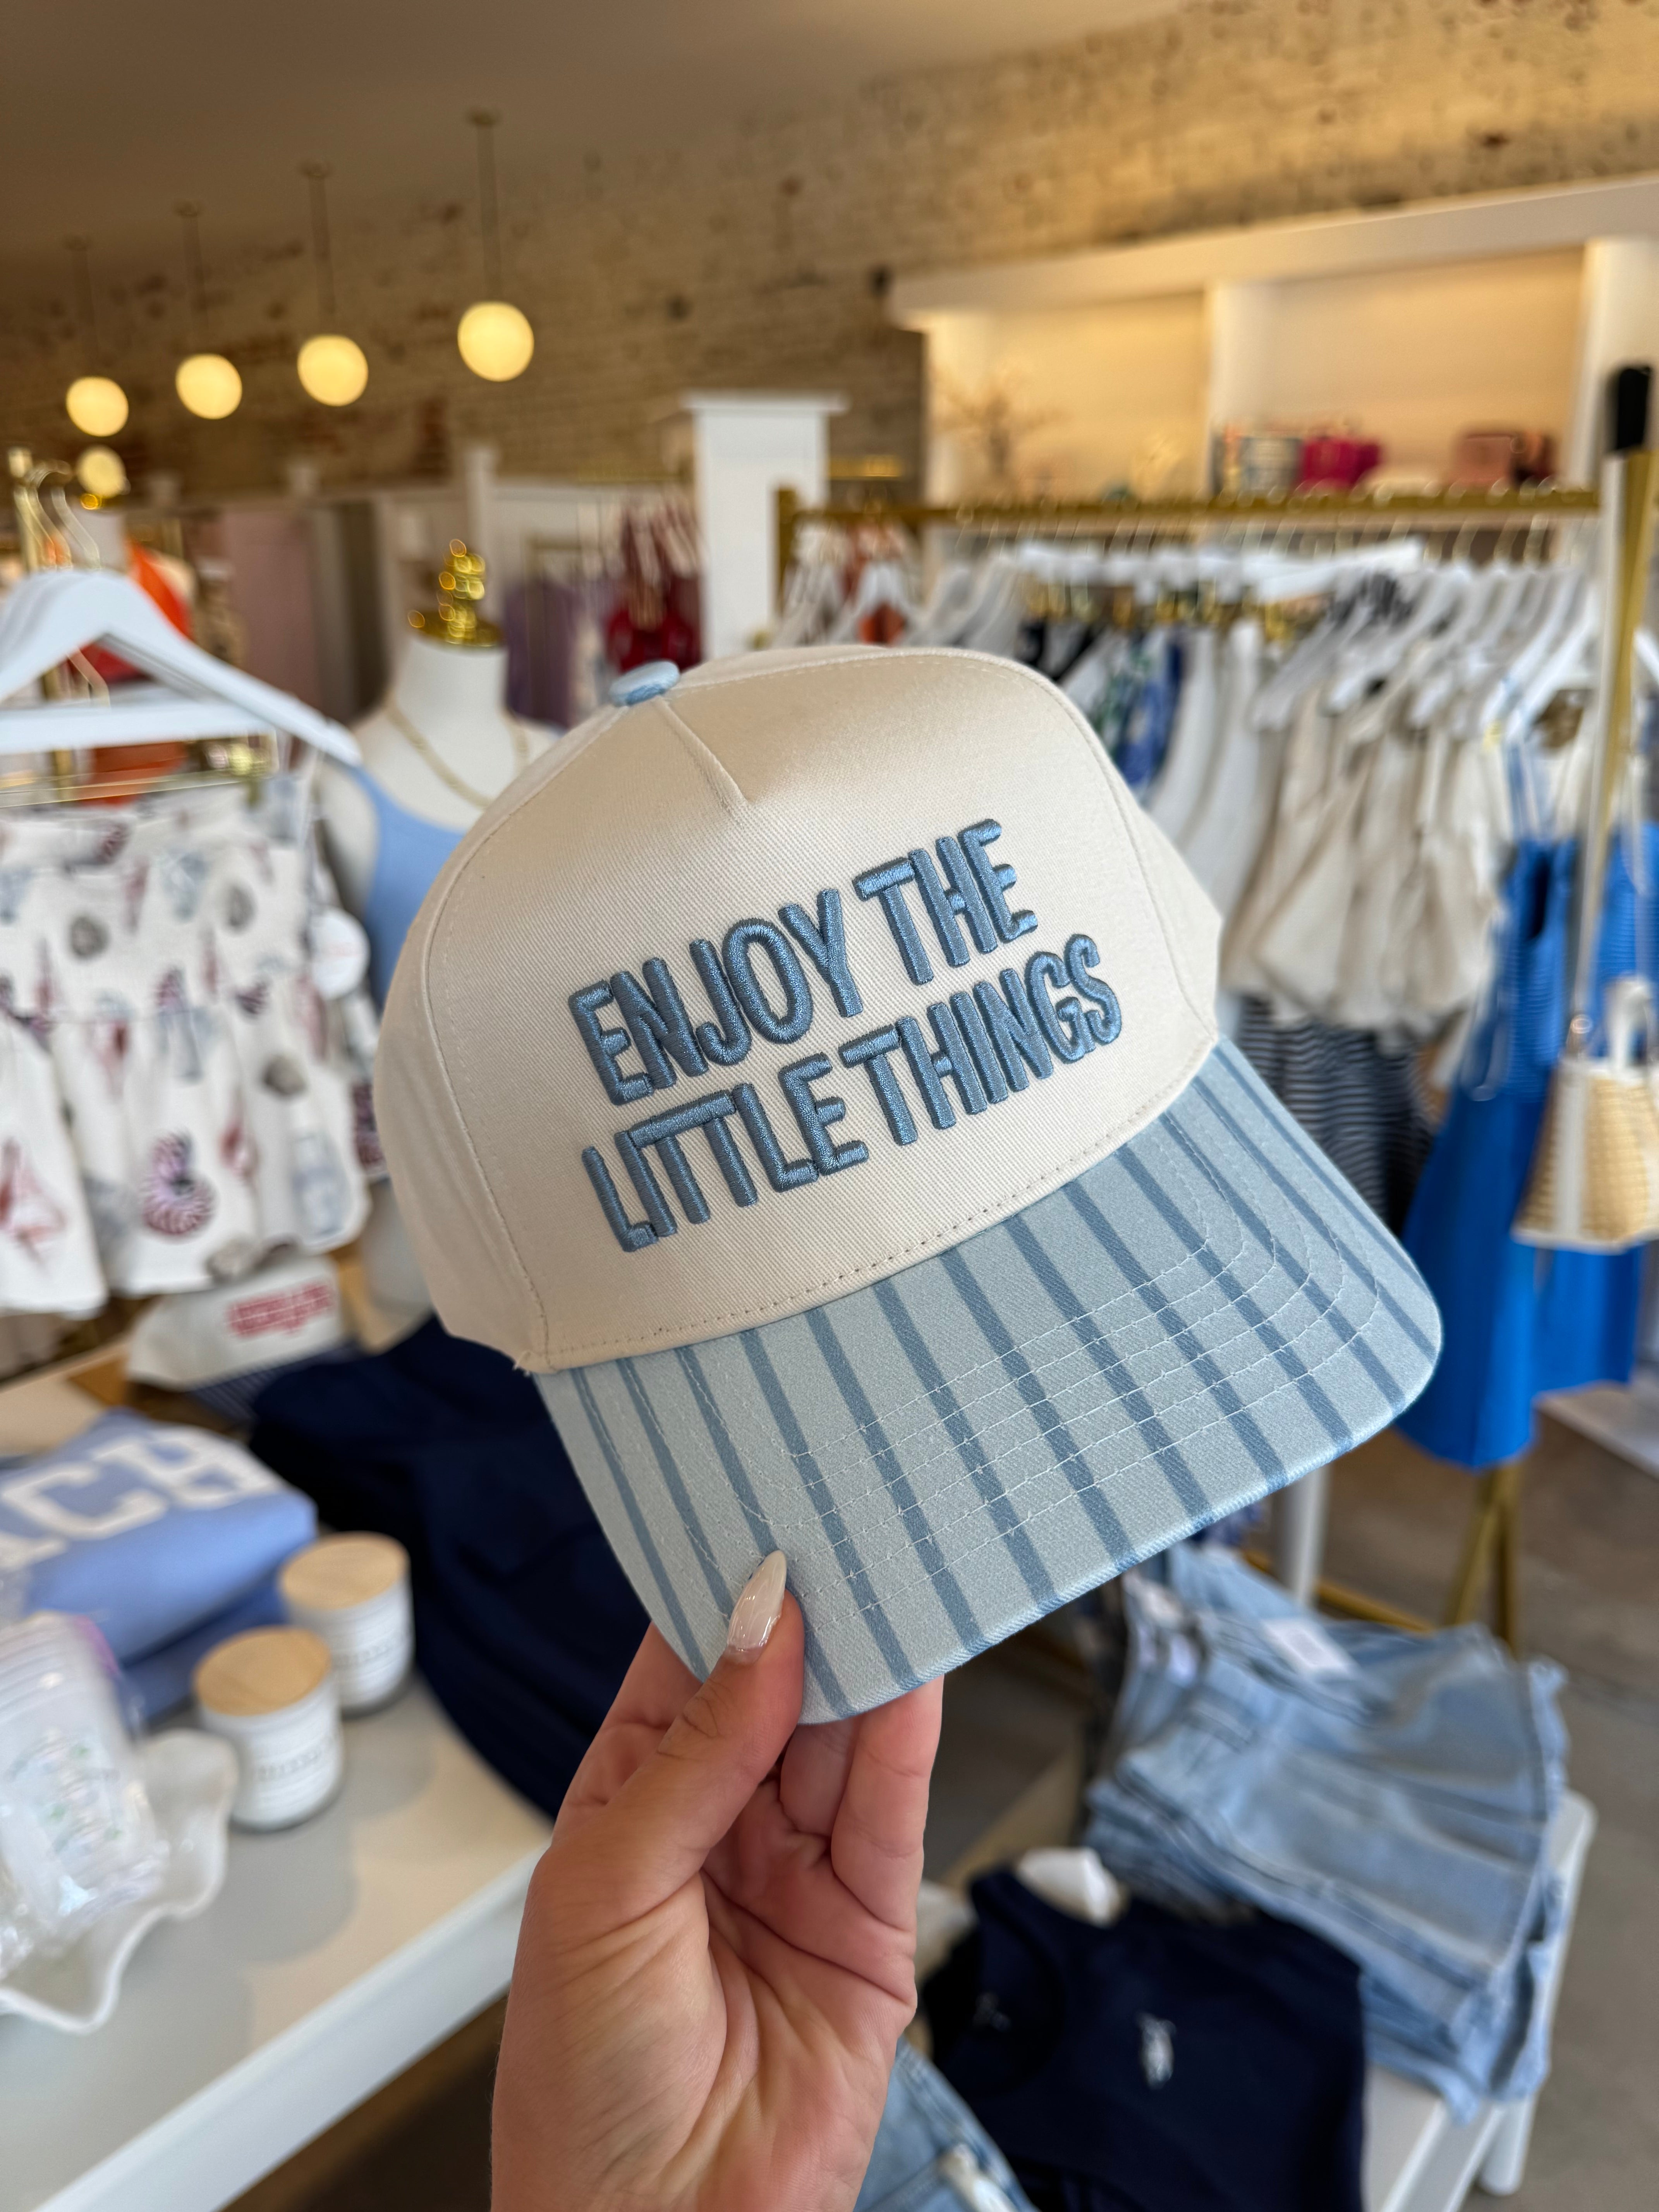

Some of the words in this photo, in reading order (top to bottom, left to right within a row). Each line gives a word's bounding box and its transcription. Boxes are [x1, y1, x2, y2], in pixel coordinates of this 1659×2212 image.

[571, 889, 864, 1105] ENJOY
[854, 819, 1039, 986] THE
[583, 1055, 869, 1251] LITTLE
[839, 934, 1123, 1146] THINGS
